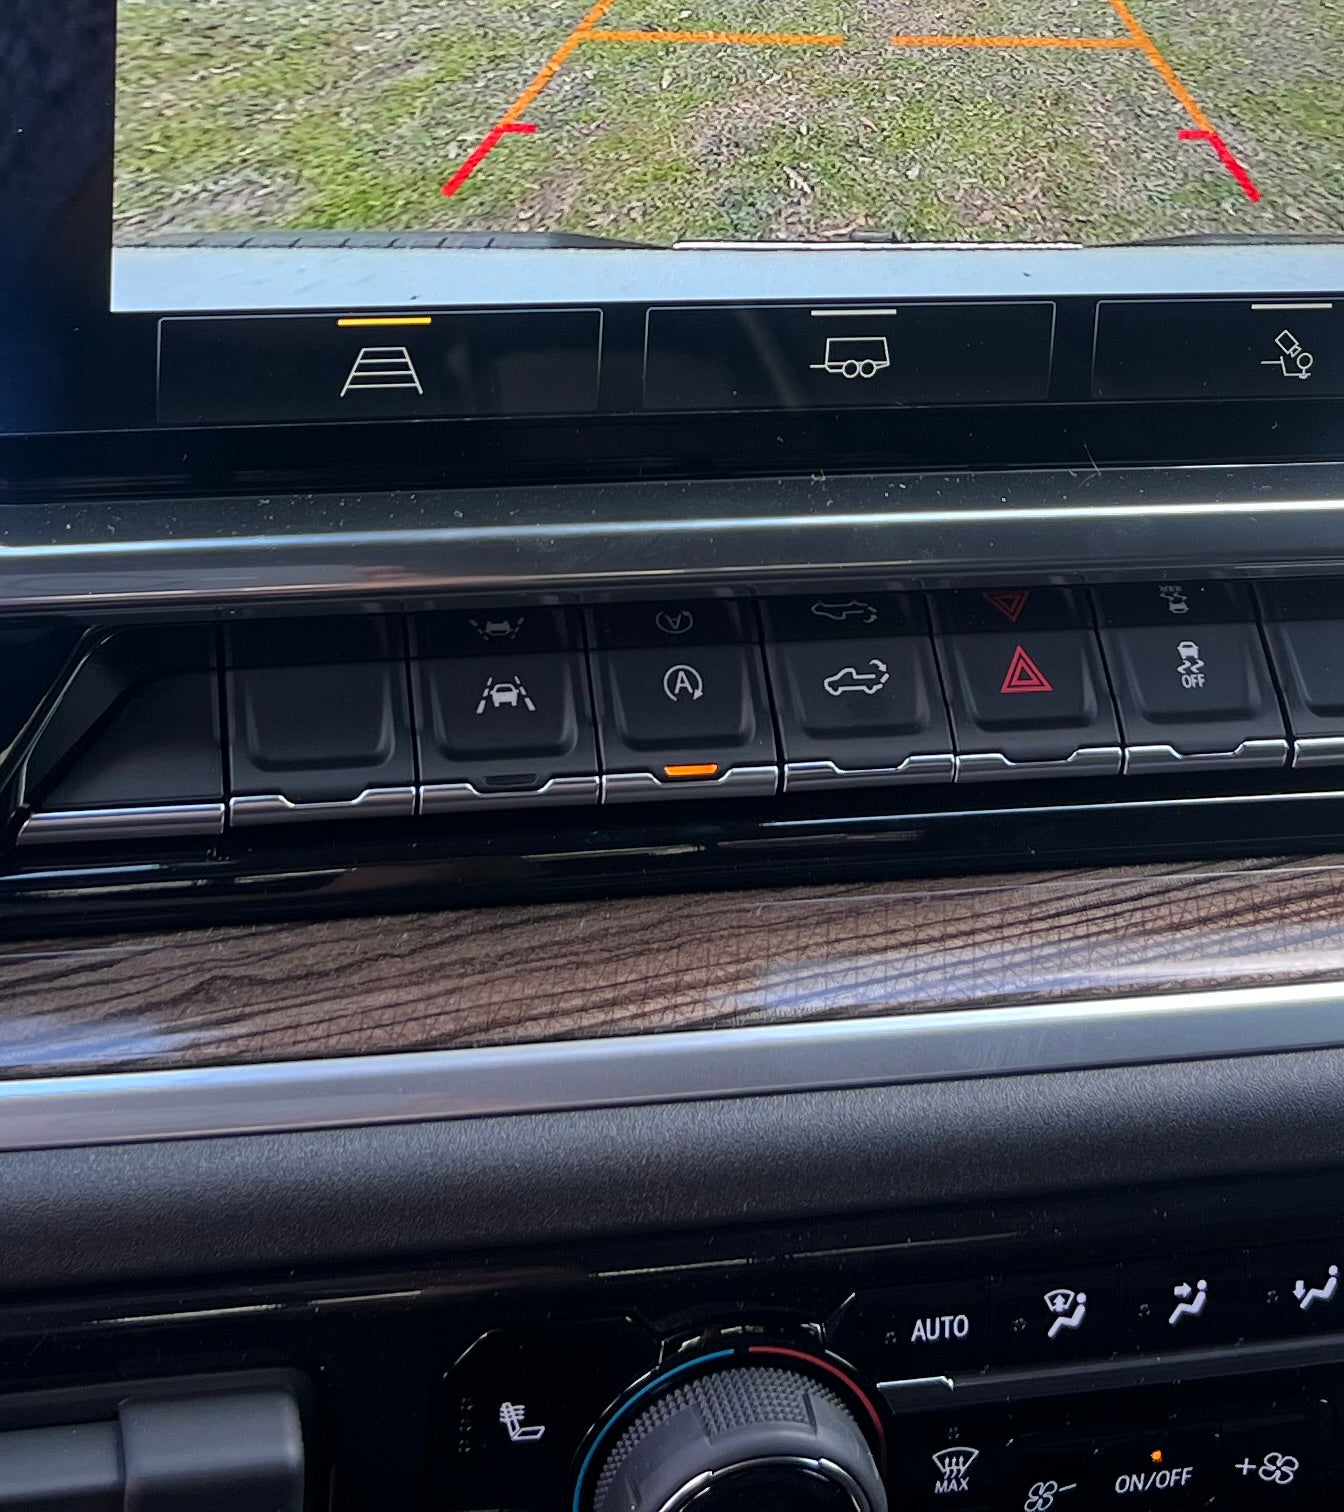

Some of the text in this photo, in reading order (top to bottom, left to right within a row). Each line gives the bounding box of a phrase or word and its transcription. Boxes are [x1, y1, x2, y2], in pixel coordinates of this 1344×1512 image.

[1181, 673, 1206, 689] OFF
[910, 1314, 969, 1343] AUTO
[934, 1476, 970, 1494] MAX
[1114, 1466, 1193, 1494] ON/OFF
